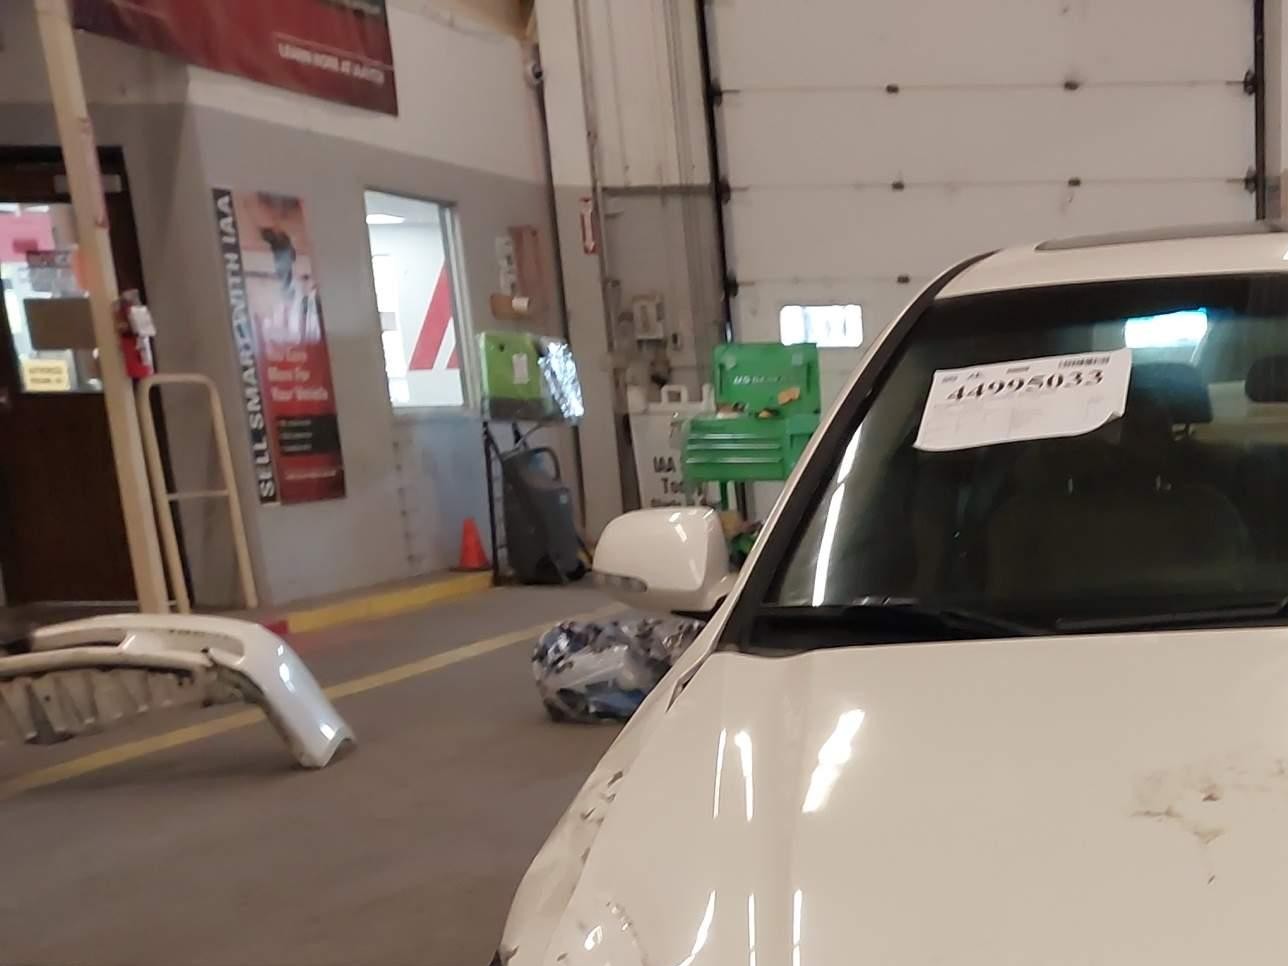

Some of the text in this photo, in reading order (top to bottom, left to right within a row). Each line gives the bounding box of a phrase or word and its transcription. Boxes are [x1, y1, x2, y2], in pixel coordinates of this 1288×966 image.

[216, 194, 237, 244] IAA
[224, 252, 247, 327] WITH
[947, 369, 1104, 401] 44995033
[253, 436, 276, 498] SELL
